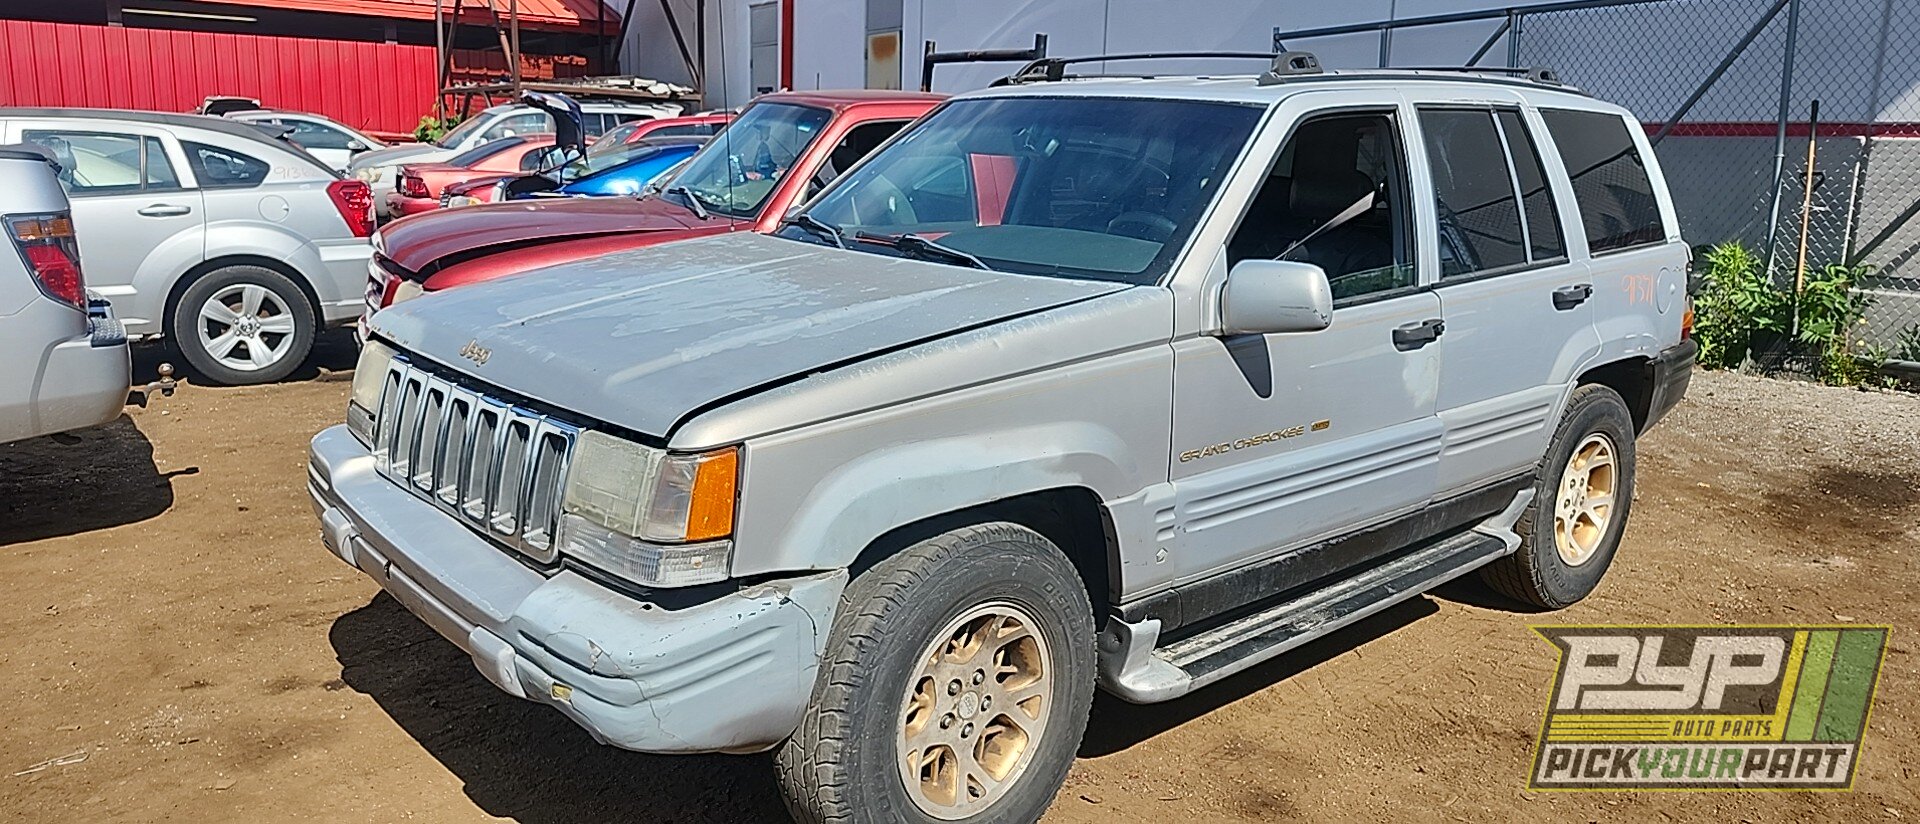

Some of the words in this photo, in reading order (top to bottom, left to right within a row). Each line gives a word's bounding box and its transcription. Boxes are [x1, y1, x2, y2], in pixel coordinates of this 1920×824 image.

[460, 339, 493, 367] Jeep
[1179, 443, 1230, 463] GRAND
[1233, 425, 1304, 450] CHEROKEE
